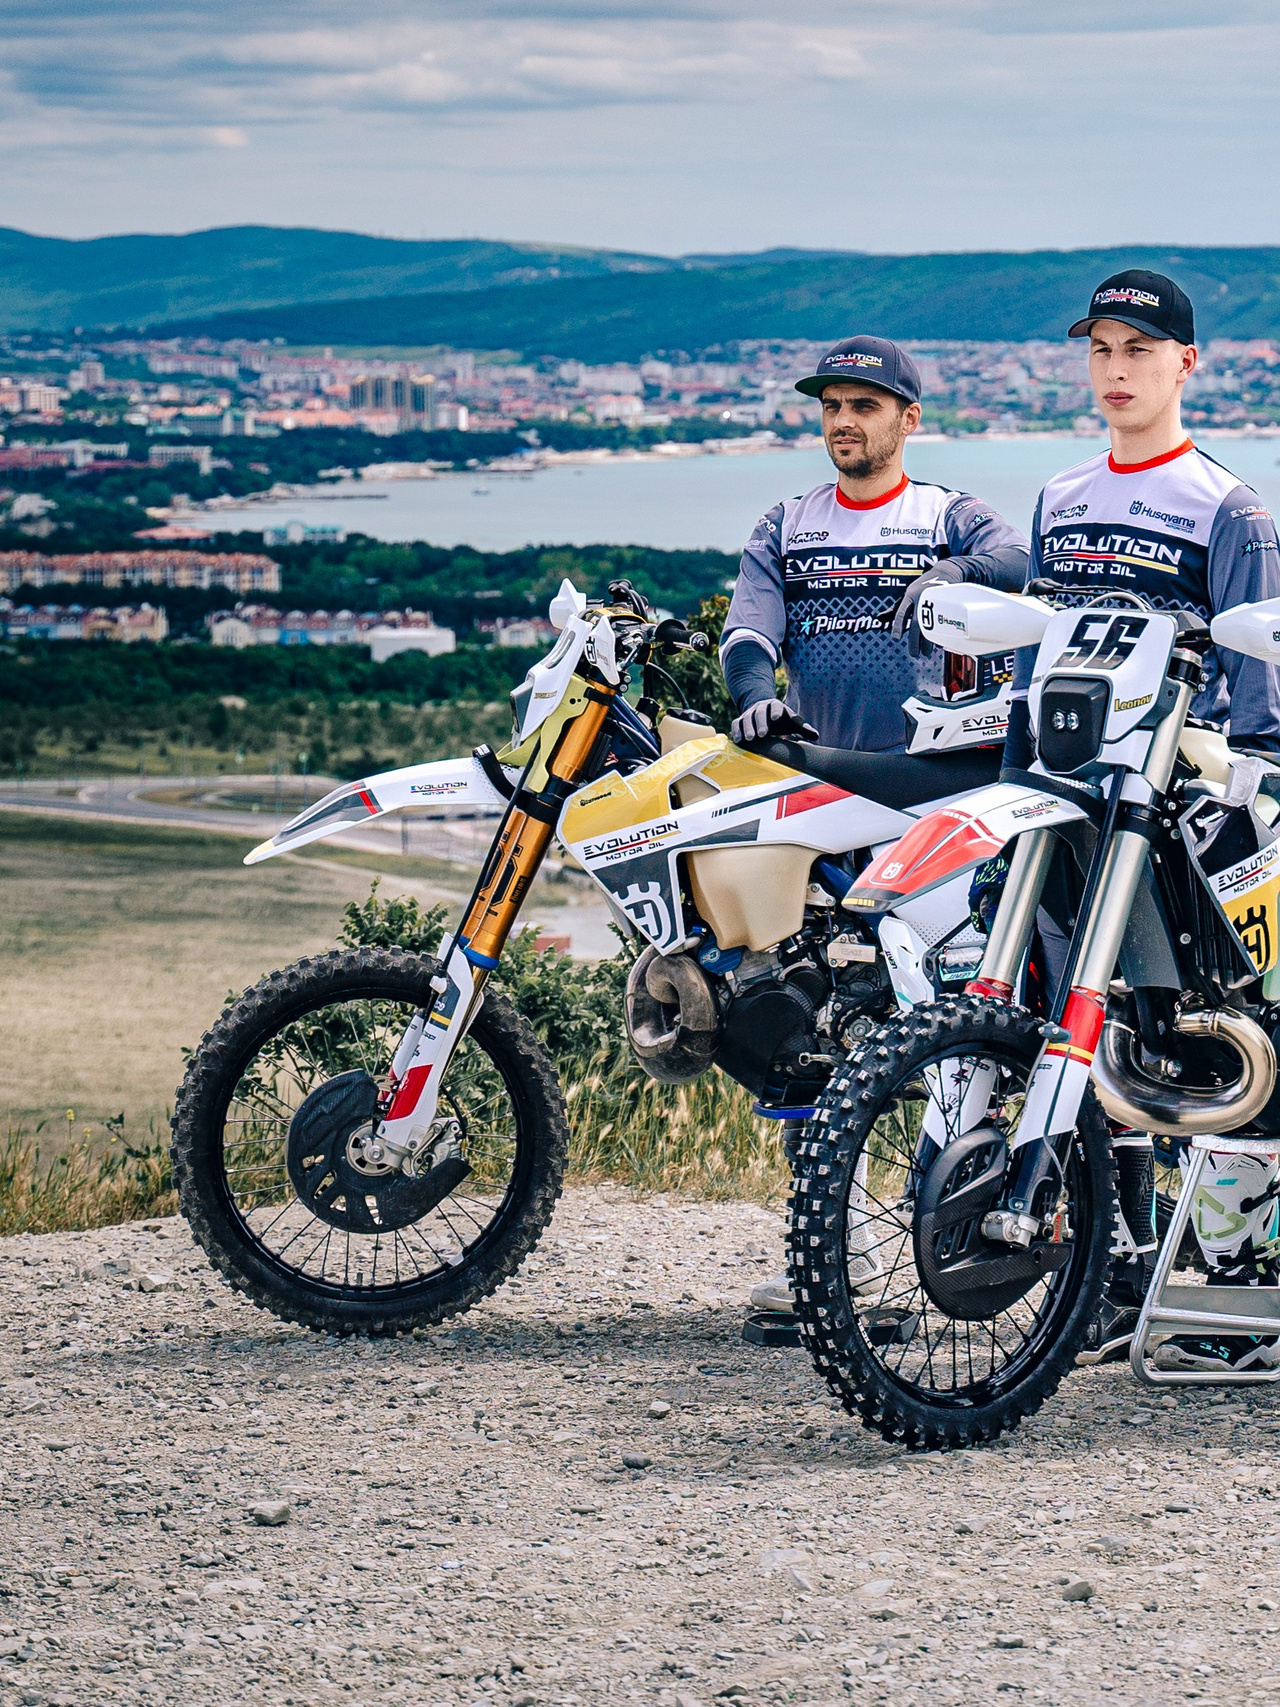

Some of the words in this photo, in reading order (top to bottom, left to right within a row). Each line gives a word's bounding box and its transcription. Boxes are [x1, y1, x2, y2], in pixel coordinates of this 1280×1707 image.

[1095, 288, 1160, 304] EVOLUTION
[1101, 296, 1127, 305] MOTOR
[1141, 507, 1196, 529] Husqvarna
[892, 527, 935, 536] Husqvarn
[1043, 534, 1183, 565] EVOLUTION
[786, 553, 939, 573] EVOLUTION
[1054, 562, 1104, 574] MOTOR
[1110, 564, 1136, 578] OIL
[808, 577, 868, 590] MOTOR
[878, 577, 906, 588] OIL
[1051, 614, 1150, 670] 56
[1114, 694, 1153, 712] Leonov
[982, 728, 1009, 736] MOT
[411, 781, 468, 791] EVOLUTION
[1011, 799, 1059, 817] EVOLUTION
[583, 821, 680, 856] EVOLUTION
[606, 847, 643, 862] MOTOR
[649, 842, 665, 850] OIL
[1218, 844, 1279, 887] EVOLUTION
[1233, 876, 1259, 893] MOTOR
